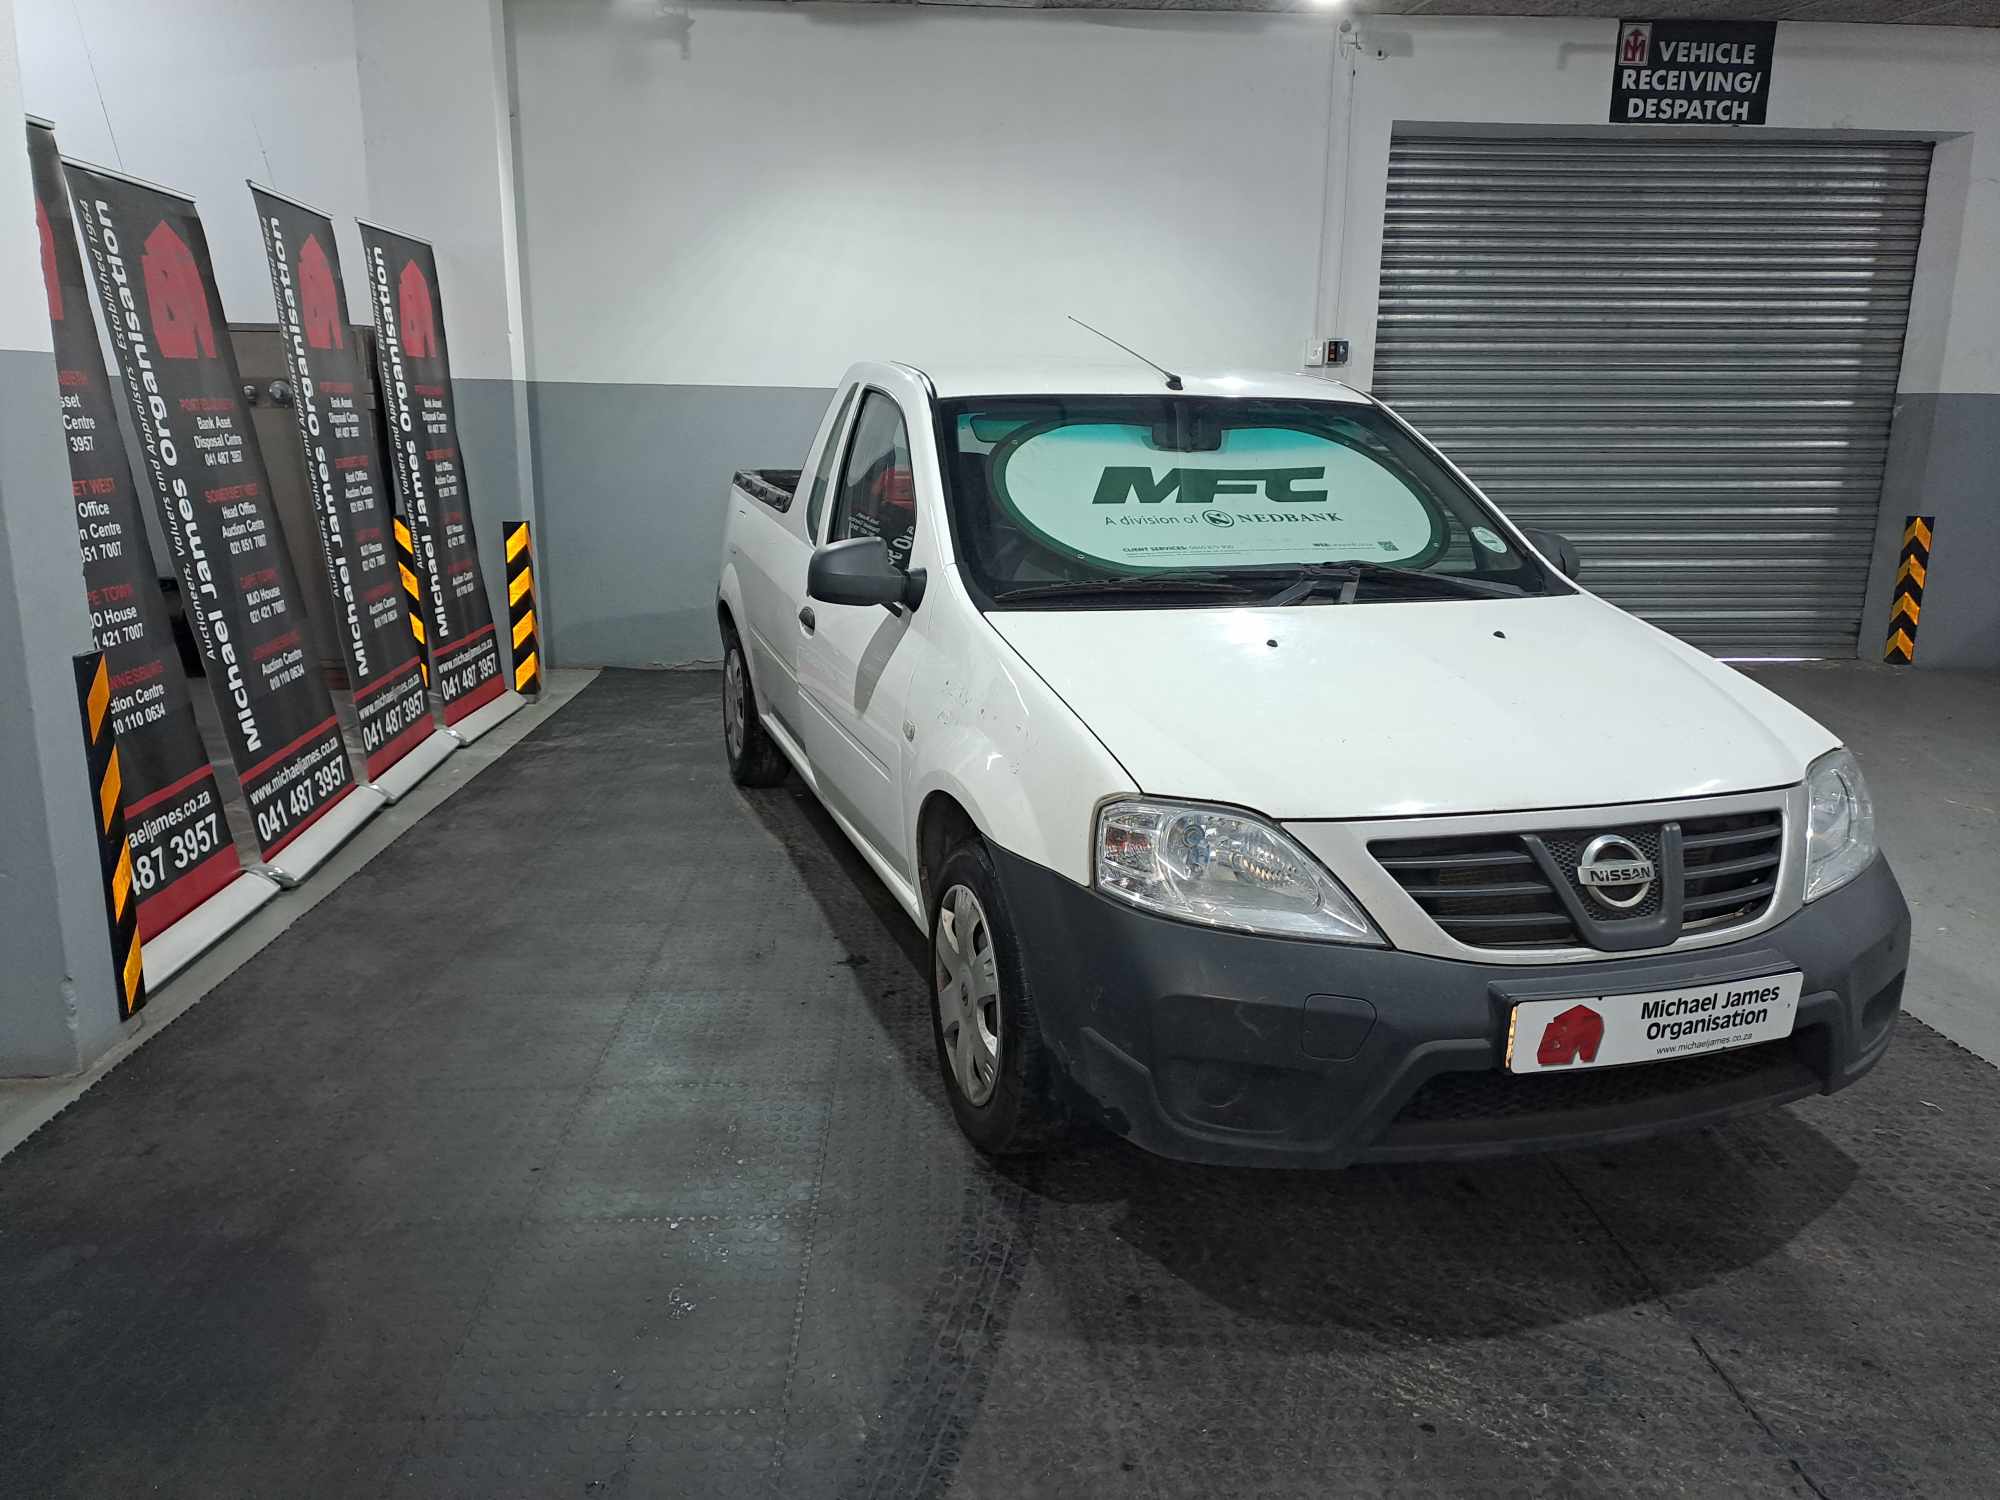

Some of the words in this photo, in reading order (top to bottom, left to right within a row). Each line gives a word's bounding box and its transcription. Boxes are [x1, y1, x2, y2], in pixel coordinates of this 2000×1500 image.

[1659, 41, 1756, 65] VEHICLE
[1621, 69, 1762, 94] RECEIVING/
[1627, 98, 1749, 121] DESPATCH
[92, 248, 127, 351] Established
[95, 200, 178, 467] Organisation
[270, 217, 321, 436] Organisation
[373, 247, 412, 432] Organisation
[126, 366, 155, 452] Appraisers
[287, 352, 305, 426] Appraisers
[382, 361, 398, 424] Appraisers
[63, 415, 96, 430] Centre
[391, 426, 402, 449] and
[70, 436, 94, 452] 3957
[300, 431, 313, 456] and
[150, 459, 167, 492] and
[306, 461, 322, 510] Valuers
[396, 452, 410, 494] Valuers
[403, 440, 429, 527] James
[1092, 466, 1328, 504] MFC
[78, 501, 110, 518] Office
[314, 446, 343, 549] James
[90, 522, 122, 538] Centre
[163, 497, 185, 557] Valuers
[173, 478, 217, 599] James
[222, 523, 246, 539] Auction
[1105, 516, 1115, 526] A
[1119, 513, 1179, 526] division
[1183, 513, 1199, 524] of
[1236, 512, 1344, 523] NEDBANK
[99, 541, 122, 559] 7007
[421, 535, 449, 637] Michael
[104, 606, 137, 625] House
[183, 563, 216, 660] Auctioneers,
[335, 557, 369, 677] Michael
[102, 629, 121, 648] 421
[123, 623, 144, 642] 7007
[136, 683, 165, 704] Centre
[208, 609, 262, 752] Michael
[441, 673, 461, 700] 041
[463, 664, 477, 688] 487
[478, 653, 496, 680] 3957
[125, 712, 144, 730] 110
[145, 702, 166, 722] 0634
[363, 719, 384, 751] 041
[386, 705, 402, 735] 487
[403, 690, 424, 722] 3957
[250, 737, 338, 805] www.michaeljames.co.za
[258, 799, 288, 841] 041
[290, 778, 314, 816] 487
[315, 755, 346, 797] 3957
[170, 813, 219, 868] 3957
[1590, 866, 1651, 882] NISSAN
[1641, 993, 1718, 1020] Michael
[1721, 986, 1780, 1009] James
[1646, 1008, 1768, 1040] Organisation
[1656, 1033, 1753, 1055] www.michaeljames.co.za
